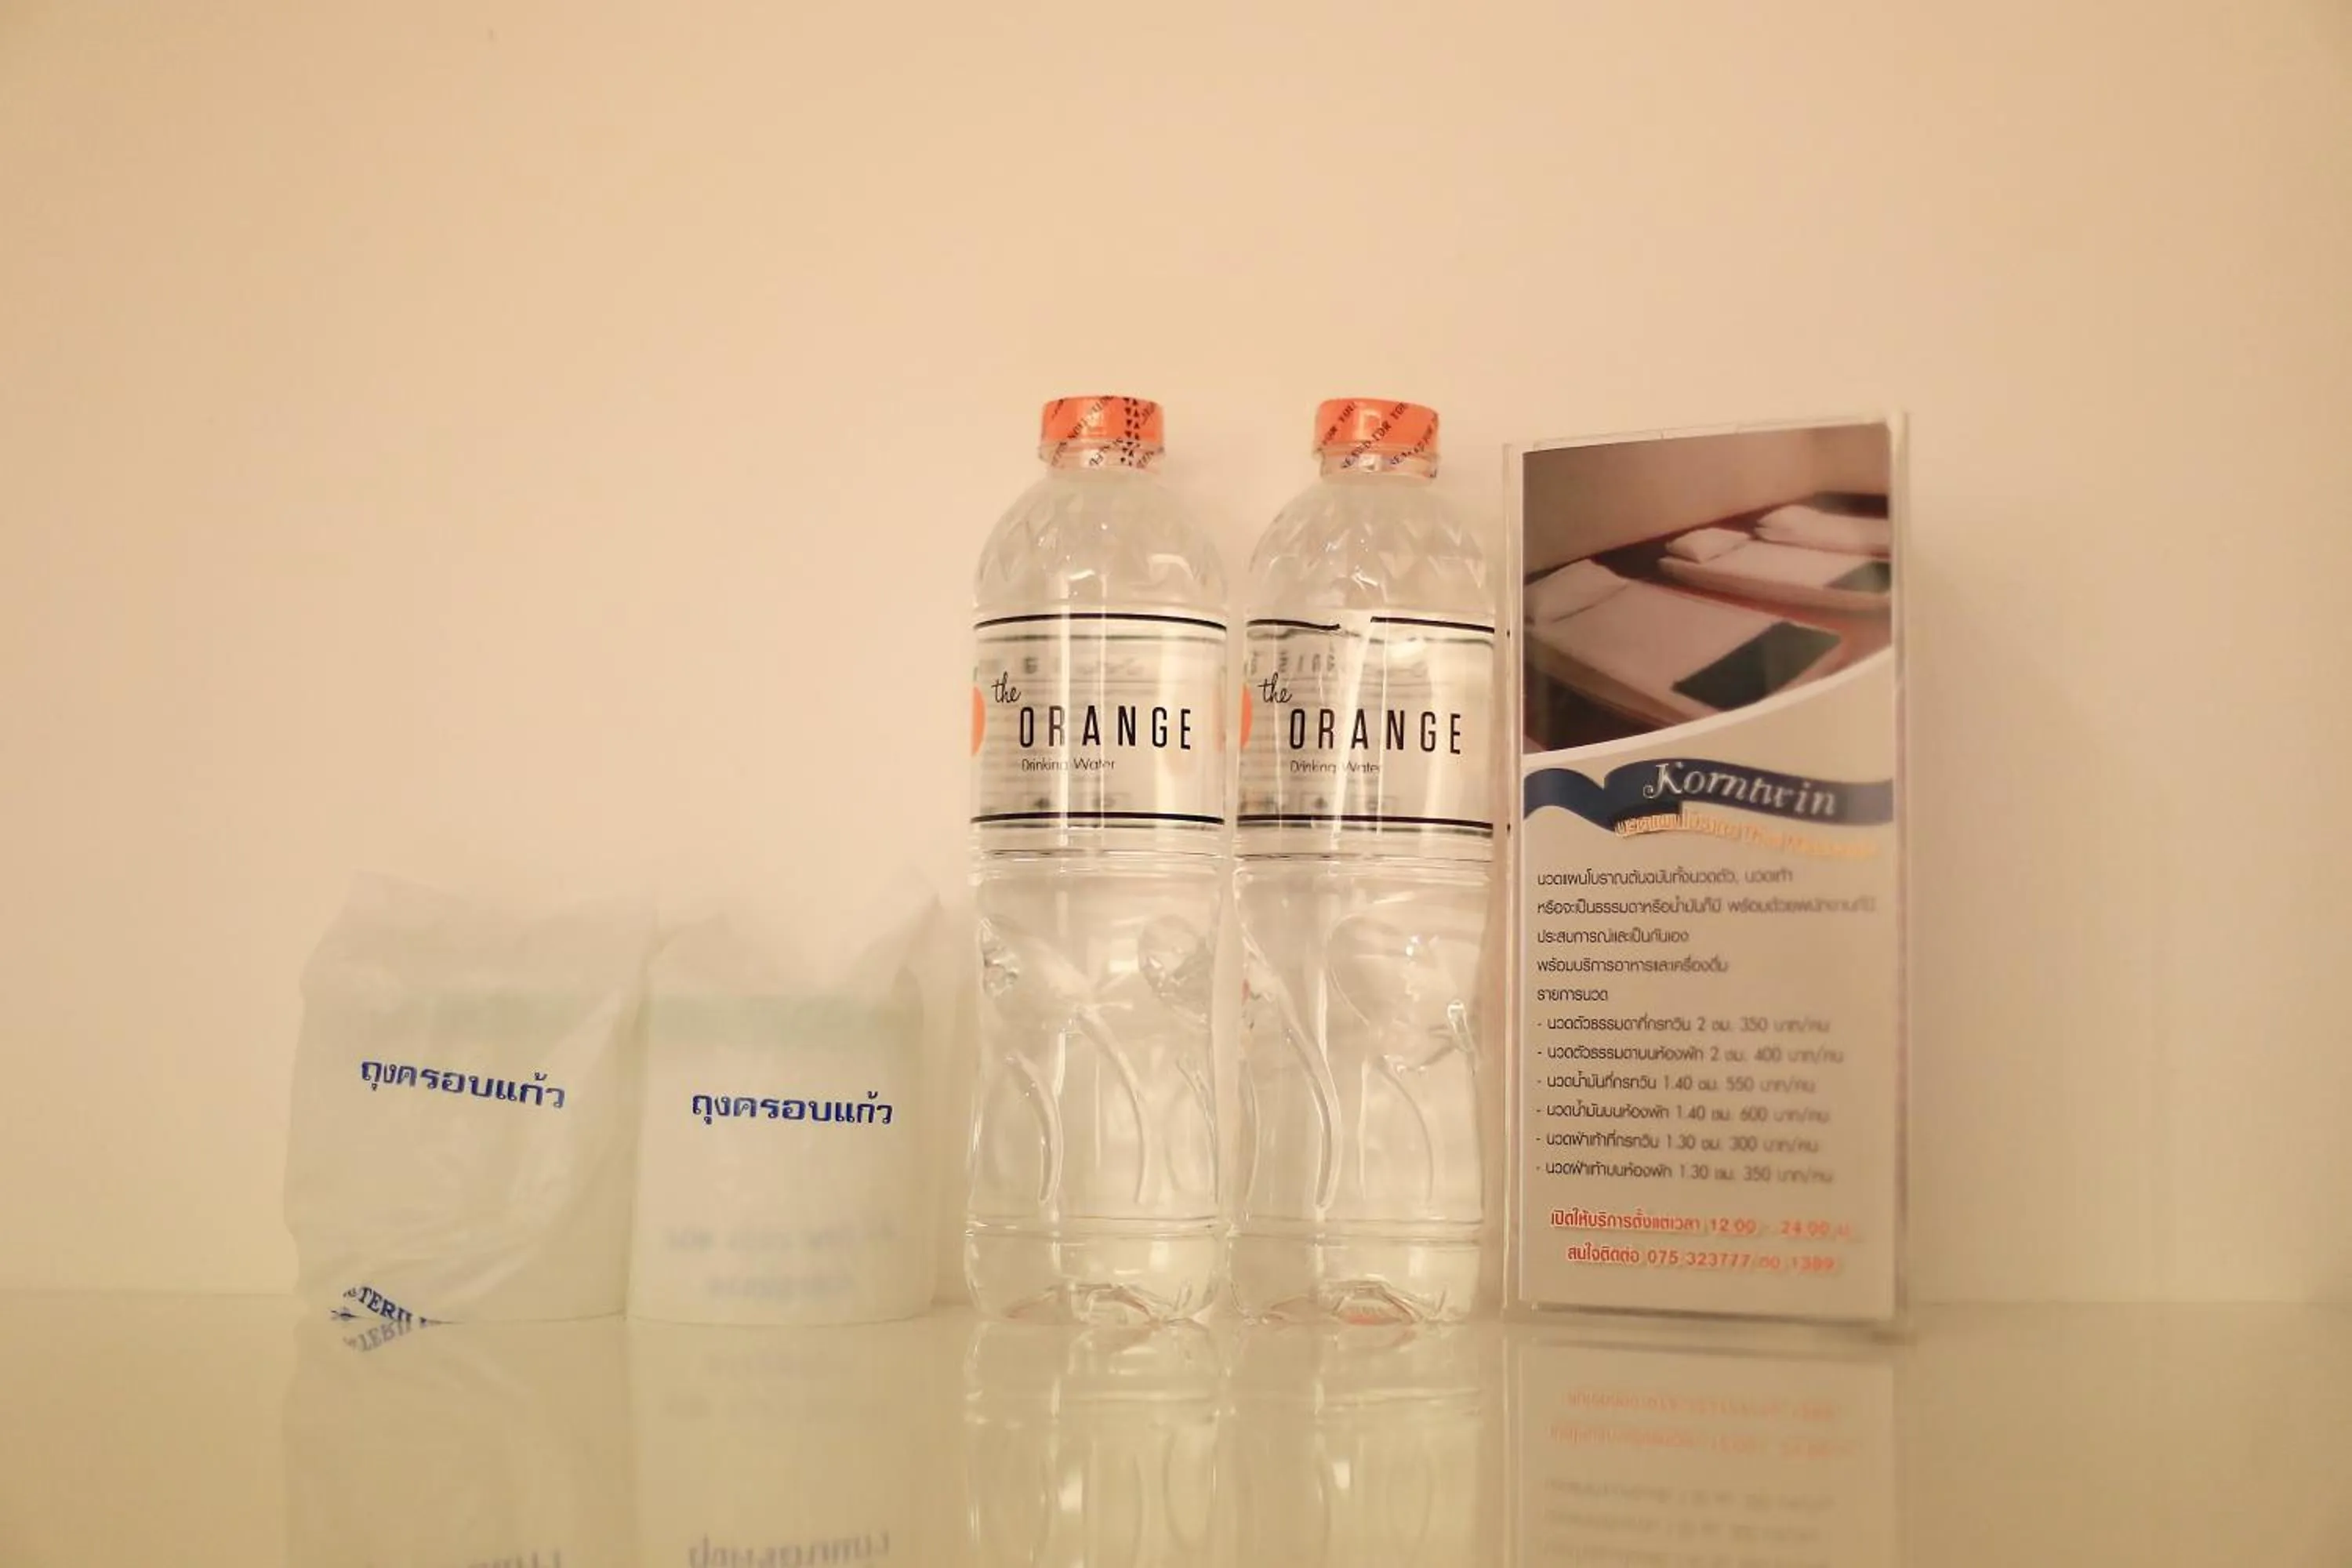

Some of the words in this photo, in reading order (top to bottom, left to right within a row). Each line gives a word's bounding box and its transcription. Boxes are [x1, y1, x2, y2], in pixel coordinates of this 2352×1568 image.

[991, 671, 1022, 703] the
[1257, 672, 1293, 704] the
[1019, 705, 1192, 750] ORANGE
[1290, 708, 1461, 755] ORANGE
[1343, 760, 1380, 772] Wate
[1642, 760, 1838, 817] Korntwin
[1537, 989, 1609, 1002] รายการนวด
[1697, 1016, 1706, 1031] 2
[1741, 1017, 1768, 1033] 350
[1710, 1046, 1719, 1061] 2
[1755, 1047, 1781, 1062] 400
[361, 1061, 566, 1109] ถุงครอบแก้ว
[1726, 1076, 1754, 1092] 550
[692, 1091, 893, 1125] ถุงครอบแก้ว
[1740, 1105, 1768, 1122] 600
[1730, 1136, 1758, 1152] 300
[1743, 1166, 1771, 1181] 350
[1648, 1250, 1679, 1264] 075
